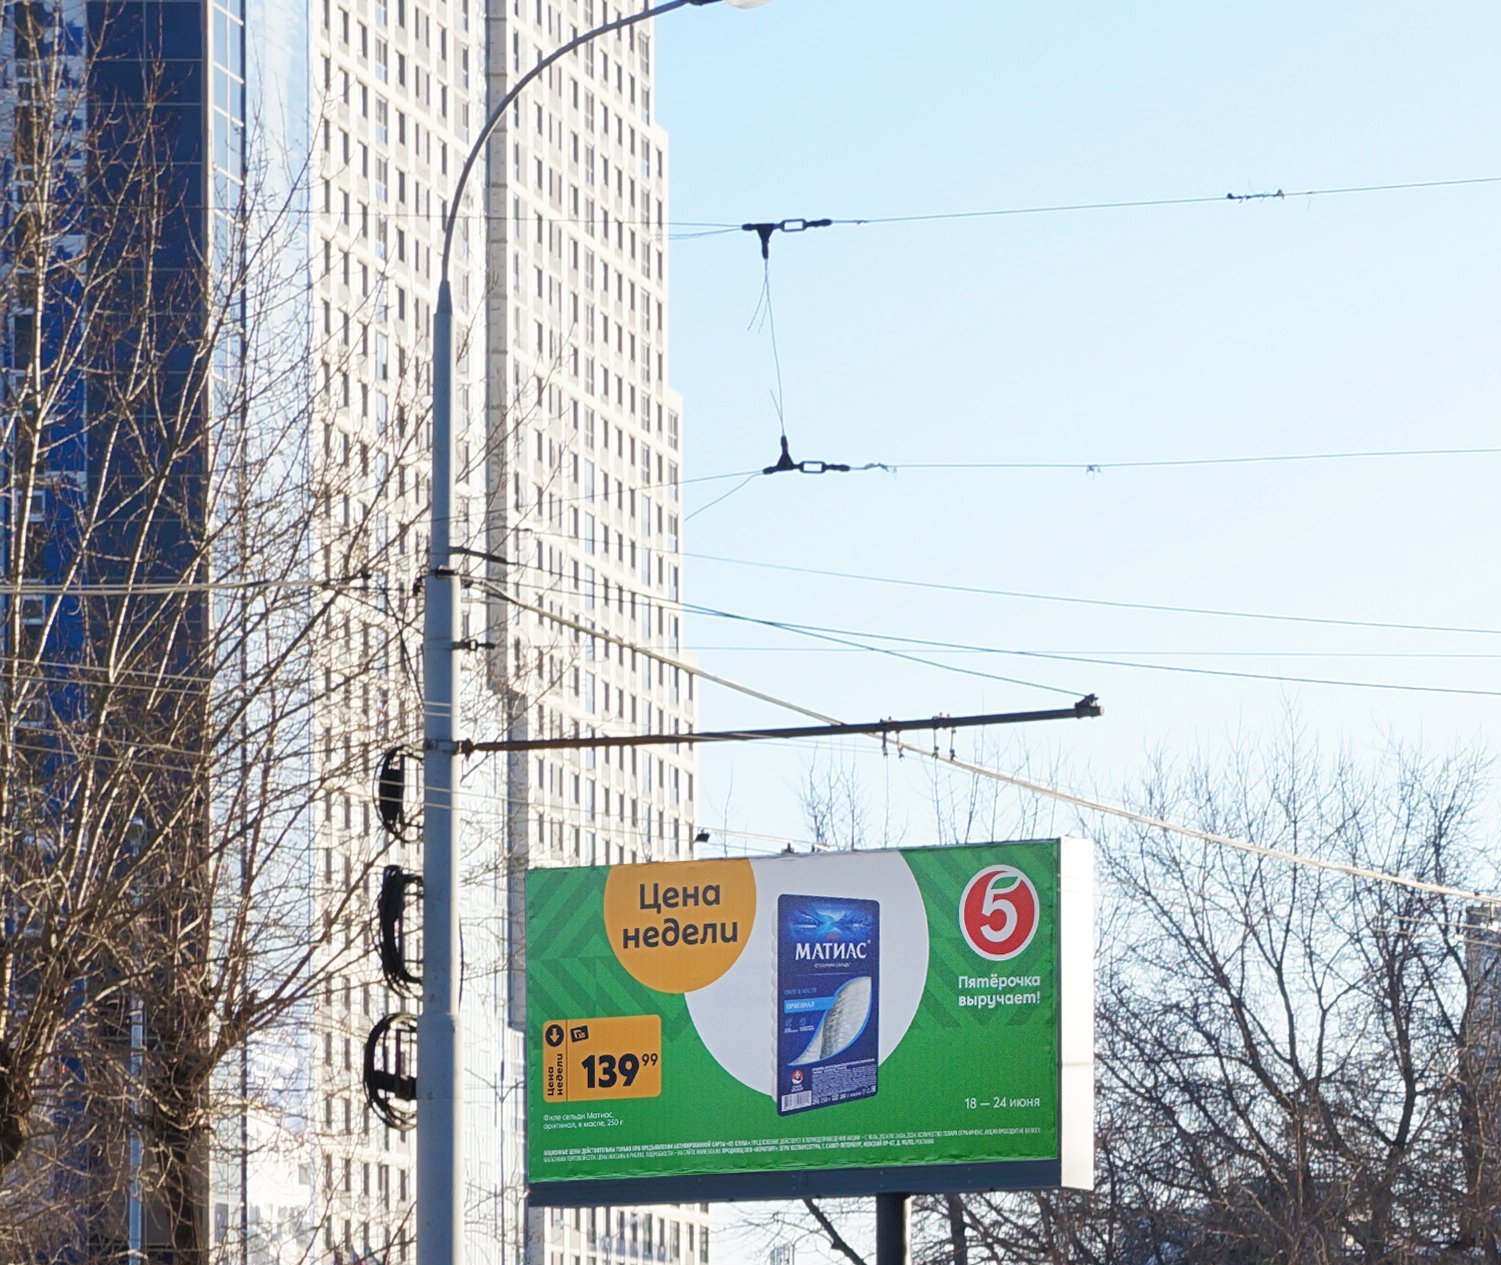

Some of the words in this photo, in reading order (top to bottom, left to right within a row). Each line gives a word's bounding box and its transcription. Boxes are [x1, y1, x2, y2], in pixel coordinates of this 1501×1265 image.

[639, 883, 722, 914] Цена
[622, 917, 739, 949] недели
[795, 942, 867, 961] МАТИАС
[957, 973, 1041, 994] Пятёрочка
[957, 990, 1041, 1010] выручает!
[547, 1066, 555, 1096] Цена
[581, 1053, 640, 1088] 139
[641, 1053, 658, 1066] 99
[964, 1097, 977, 1109] 18
[992, 1096, 1007, 1108] 24
[1008, 1096, 1040, 1107] июня
